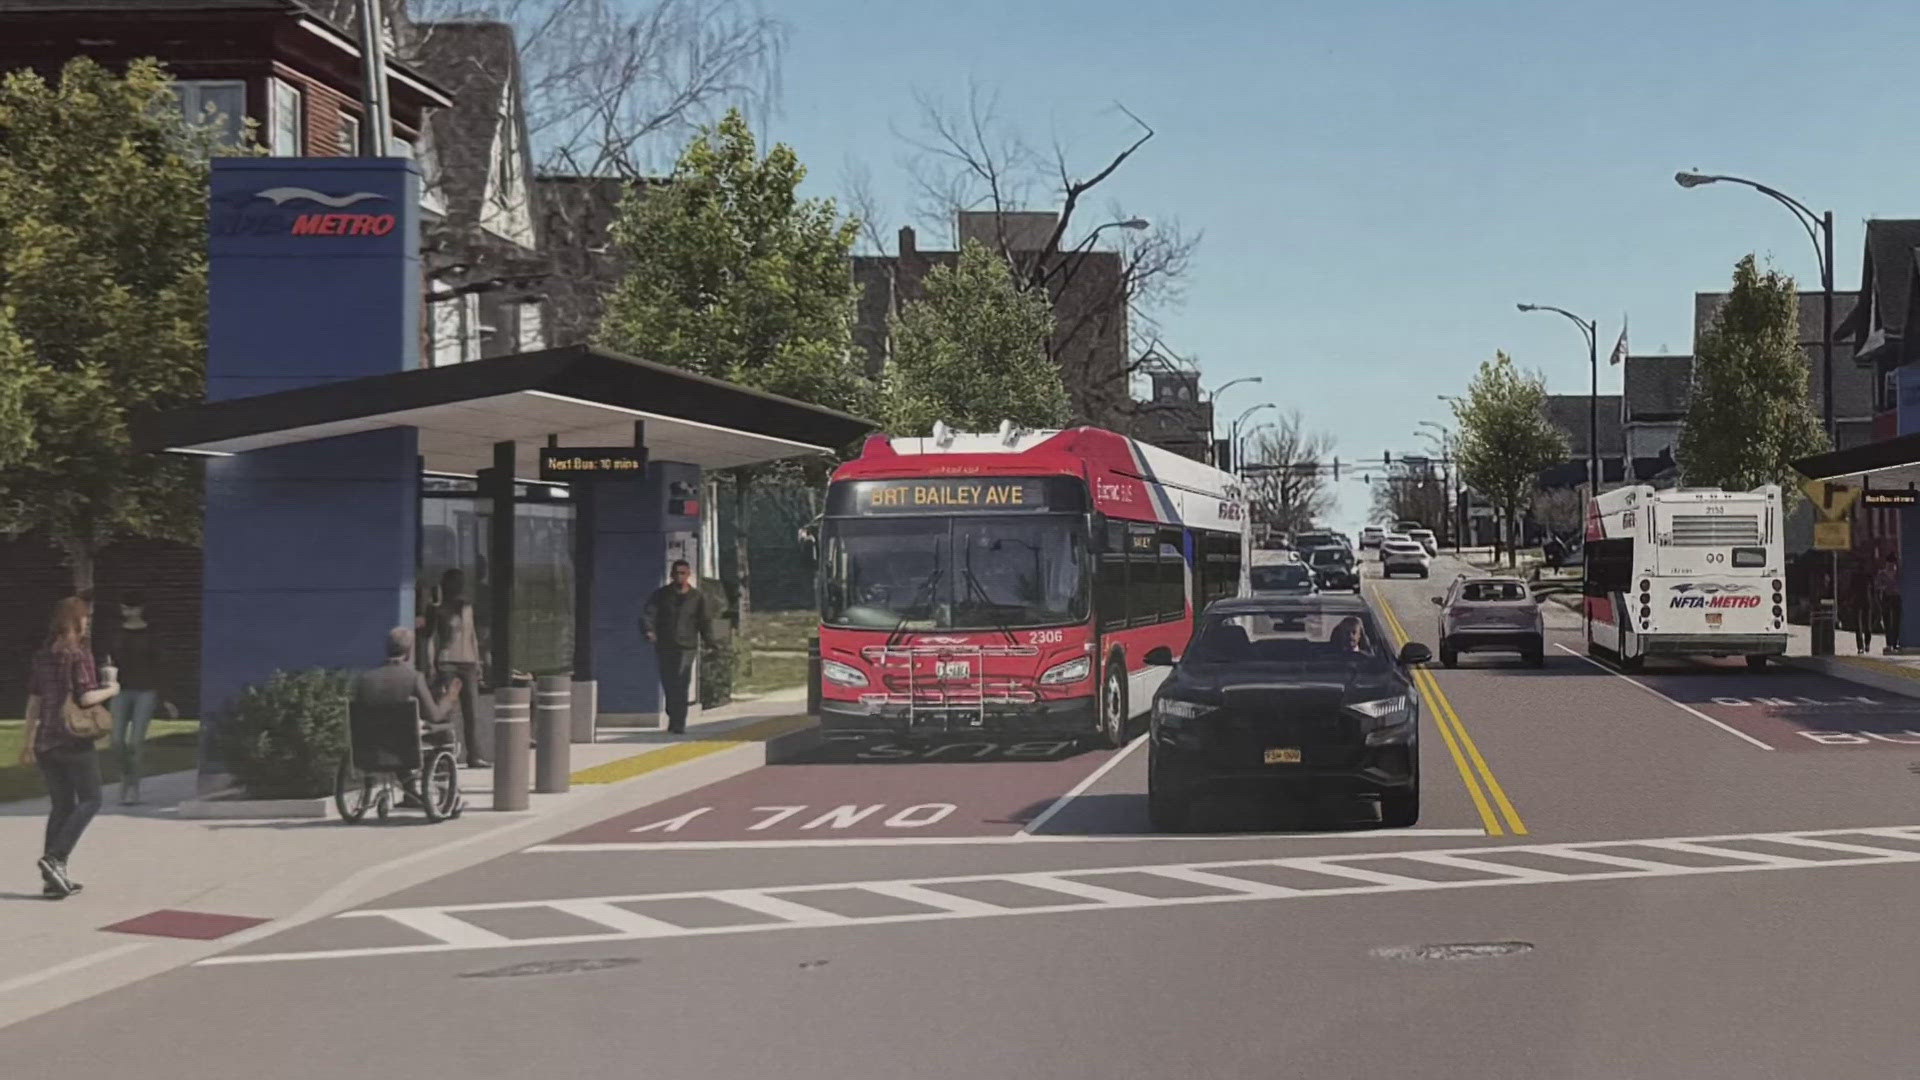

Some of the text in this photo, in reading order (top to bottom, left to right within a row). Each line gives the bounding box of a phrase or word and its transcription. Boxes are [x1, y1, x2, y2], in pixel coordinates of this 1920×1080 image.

[292, 214, 395, 236] METRO
[548, 457, 571, 470] Next
[871, 486, 1023, 506] BRT BAILEY AVE
[1029, 630, 1063, 644] 2306
[628, 802, 958, 833] ONLY
